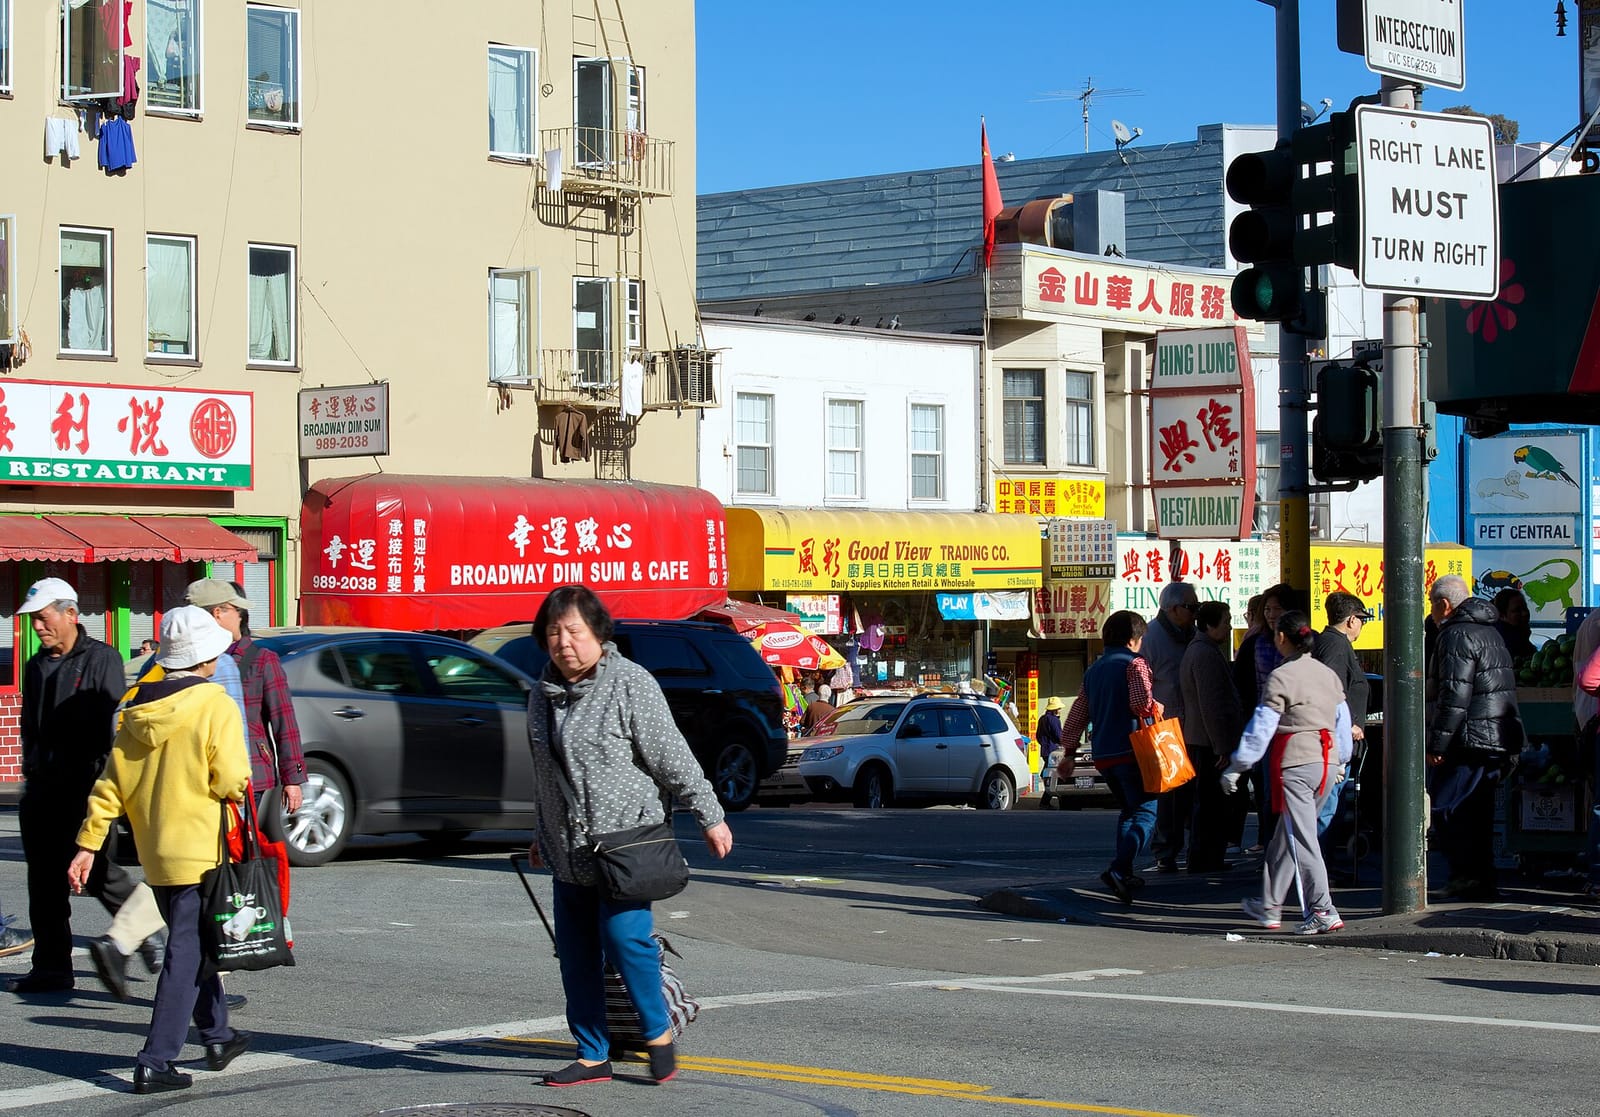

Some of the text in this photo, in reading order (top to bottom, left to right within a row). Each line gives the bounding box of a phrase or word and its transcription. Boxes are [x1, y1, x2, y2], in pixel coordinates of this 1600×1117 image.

[1375, 14, 1455, 57] INTERSECTION
[1388, 51, 1437, 74] CVC SEC 22526
[1369, 138, 1486, 171] RIGHT LANE
[1392, 186, 1468, 220] MUST
[1371, 236, 1488, 267] TURN RIGHT
[1158, 340, 1236, 377] HING LUNG
[308, 394, 376, 420] 幸運點心
[303, 418, 381, 437] BROADWAY DIM SUM
[315, 435, 369, 450] 989-2038
[8, 460, 228, 482] RESTAURANT
[999, 481, 1056, 497] 中國房產
[999, 499, 1056, 514] 生意買賣
[1159, 496, 1240, 527] RESTAURANT
[507, 514, 633, 557] 幸運點心
[1479, 523, 1571, 541] PET CENTRAL
[323, 535, 377, 571] 幸運
[848, 540, 1010, 561] Good View TRADING CO.
[450, 560, 689, 586] BROADWAY DIM SUM & CAFE
[1051, 565, 1083, 573] WESTERN
[312, 575, 377, 591] 989-2038
[831, 578, 976, 591] Daily Supplies Kitchen Retail & Wholesale
[942, 597, 968, 610] PLAY
[1034, 584, 1106, 614] 金山華人
